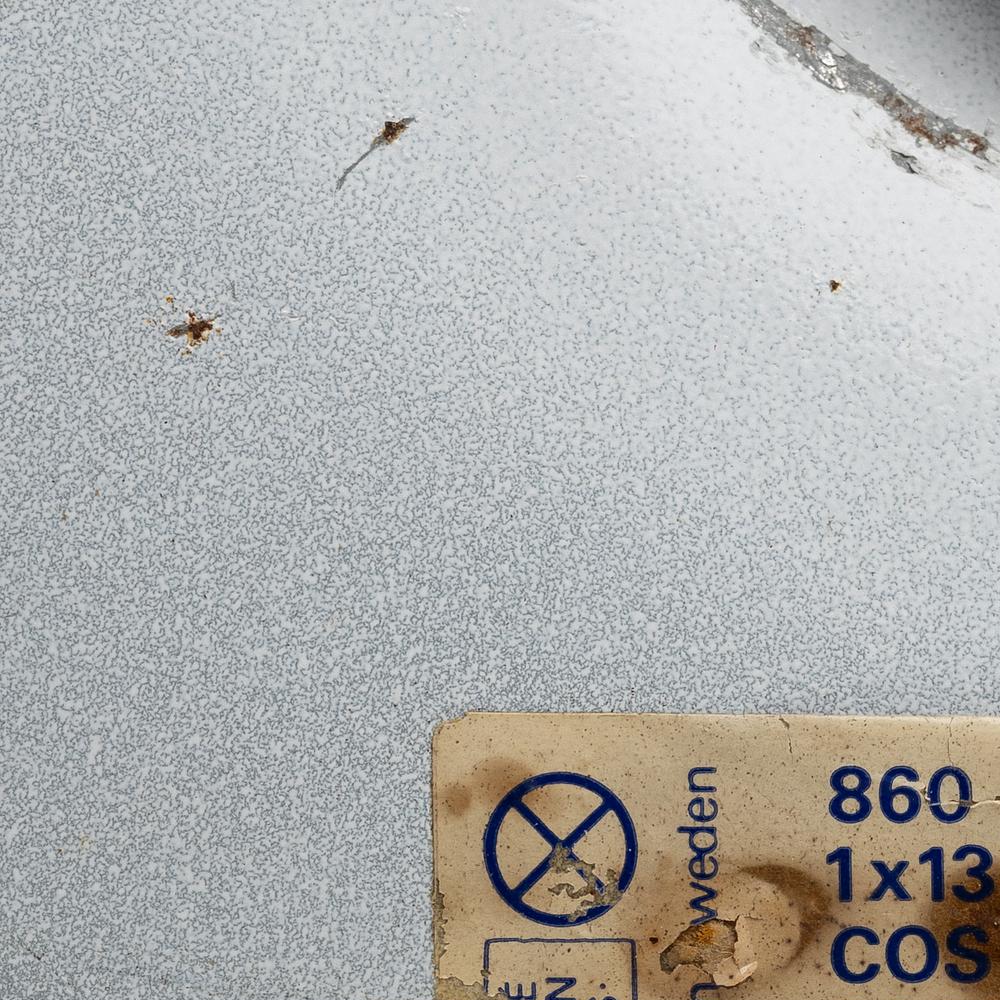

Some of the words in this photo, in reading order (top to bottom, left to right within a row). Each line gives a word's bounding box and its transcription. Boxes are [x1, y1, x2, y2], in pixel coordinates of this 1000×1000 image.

[828, 765, 972, 824] 860
[678, 766, 718, 926] weden
[830, 925, 990, 984] COS
